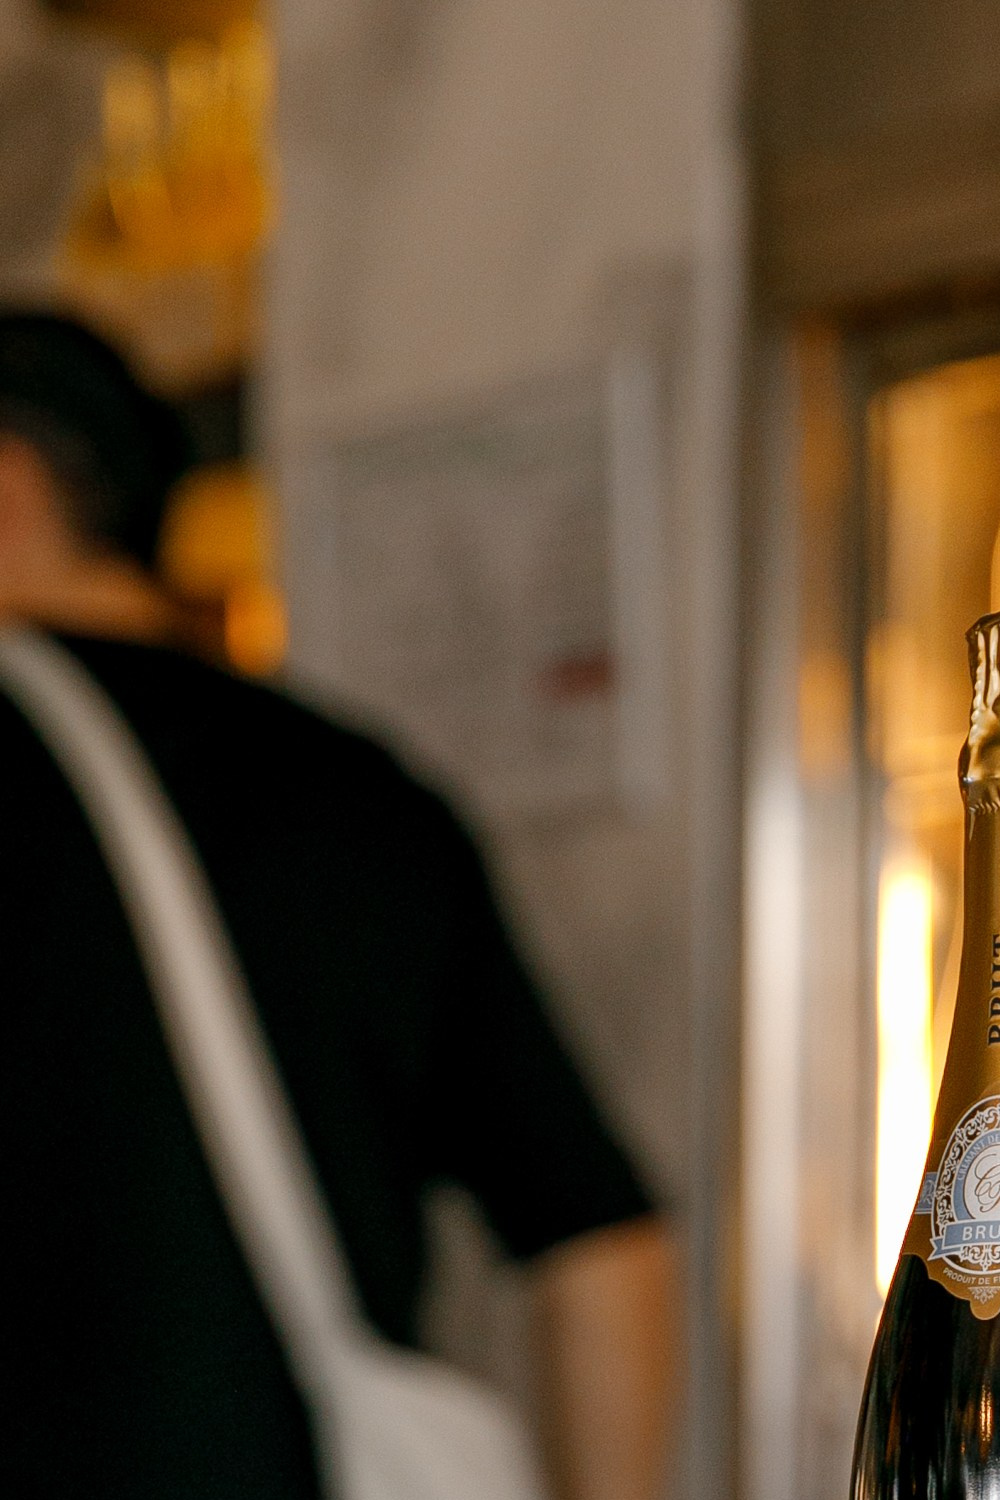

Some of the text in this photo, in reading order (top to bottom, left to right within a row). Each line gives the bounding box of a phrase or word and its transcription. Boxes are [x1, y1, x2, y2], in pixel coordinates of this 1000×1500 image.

[987, 1134, 1000, 1145] DE
[942, 1267, 977, 1285] PRODUIT
[977, 1276, 990, 1285] DE
